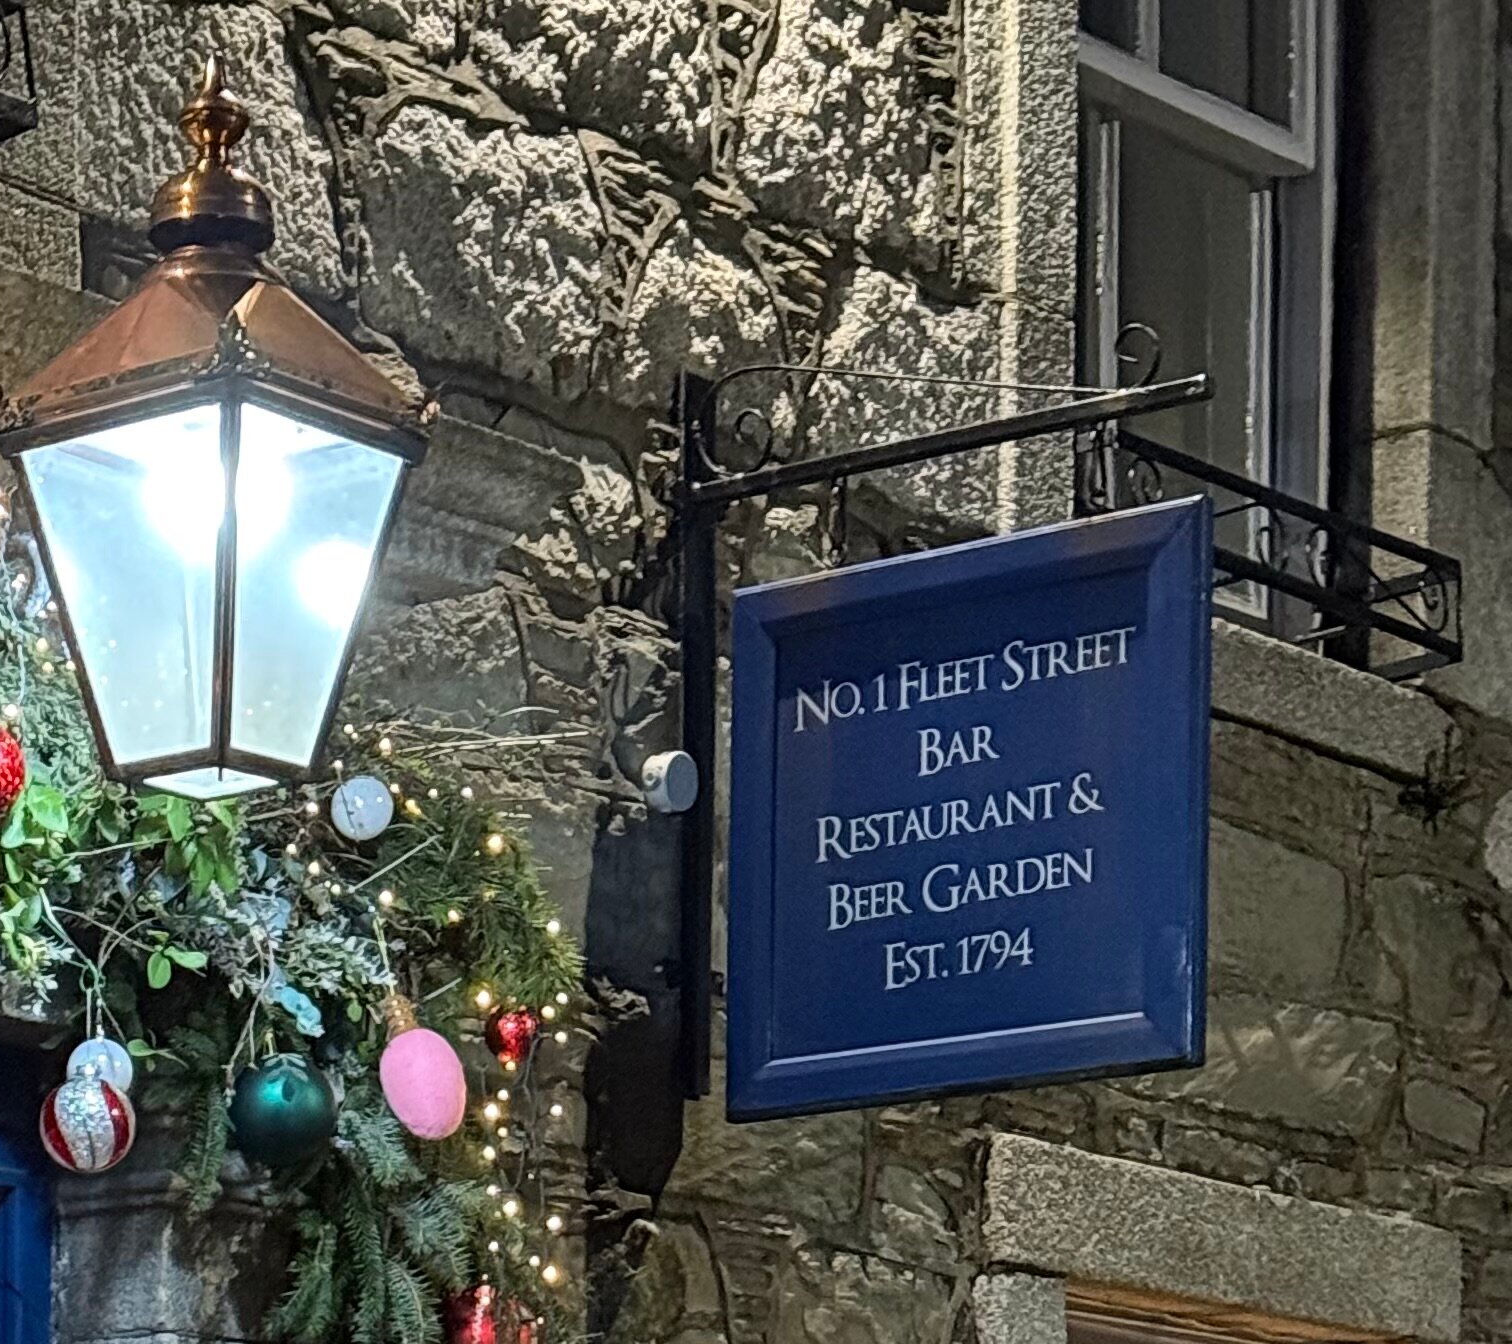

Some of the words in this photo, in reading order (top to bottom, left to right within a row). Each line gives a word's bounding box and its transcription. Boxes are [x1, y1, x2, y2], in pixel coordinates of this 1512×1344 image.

[873, 673, 888, 713] 1
[897, 653, 995, 711] FLEET
[1001, 626, 1137, 692] STREET
[917, 725, 1001, 777] BAR
[815, 781, 1062, 864] RESTAURANT
[1068, 772, 1105, 815] &
[827, 880, 913, 931] BEER
[922, 848, 1093, 913] GARDEN
[884, 941, 949, 990] EST.
[956, 927, 1034, 975] 1794
